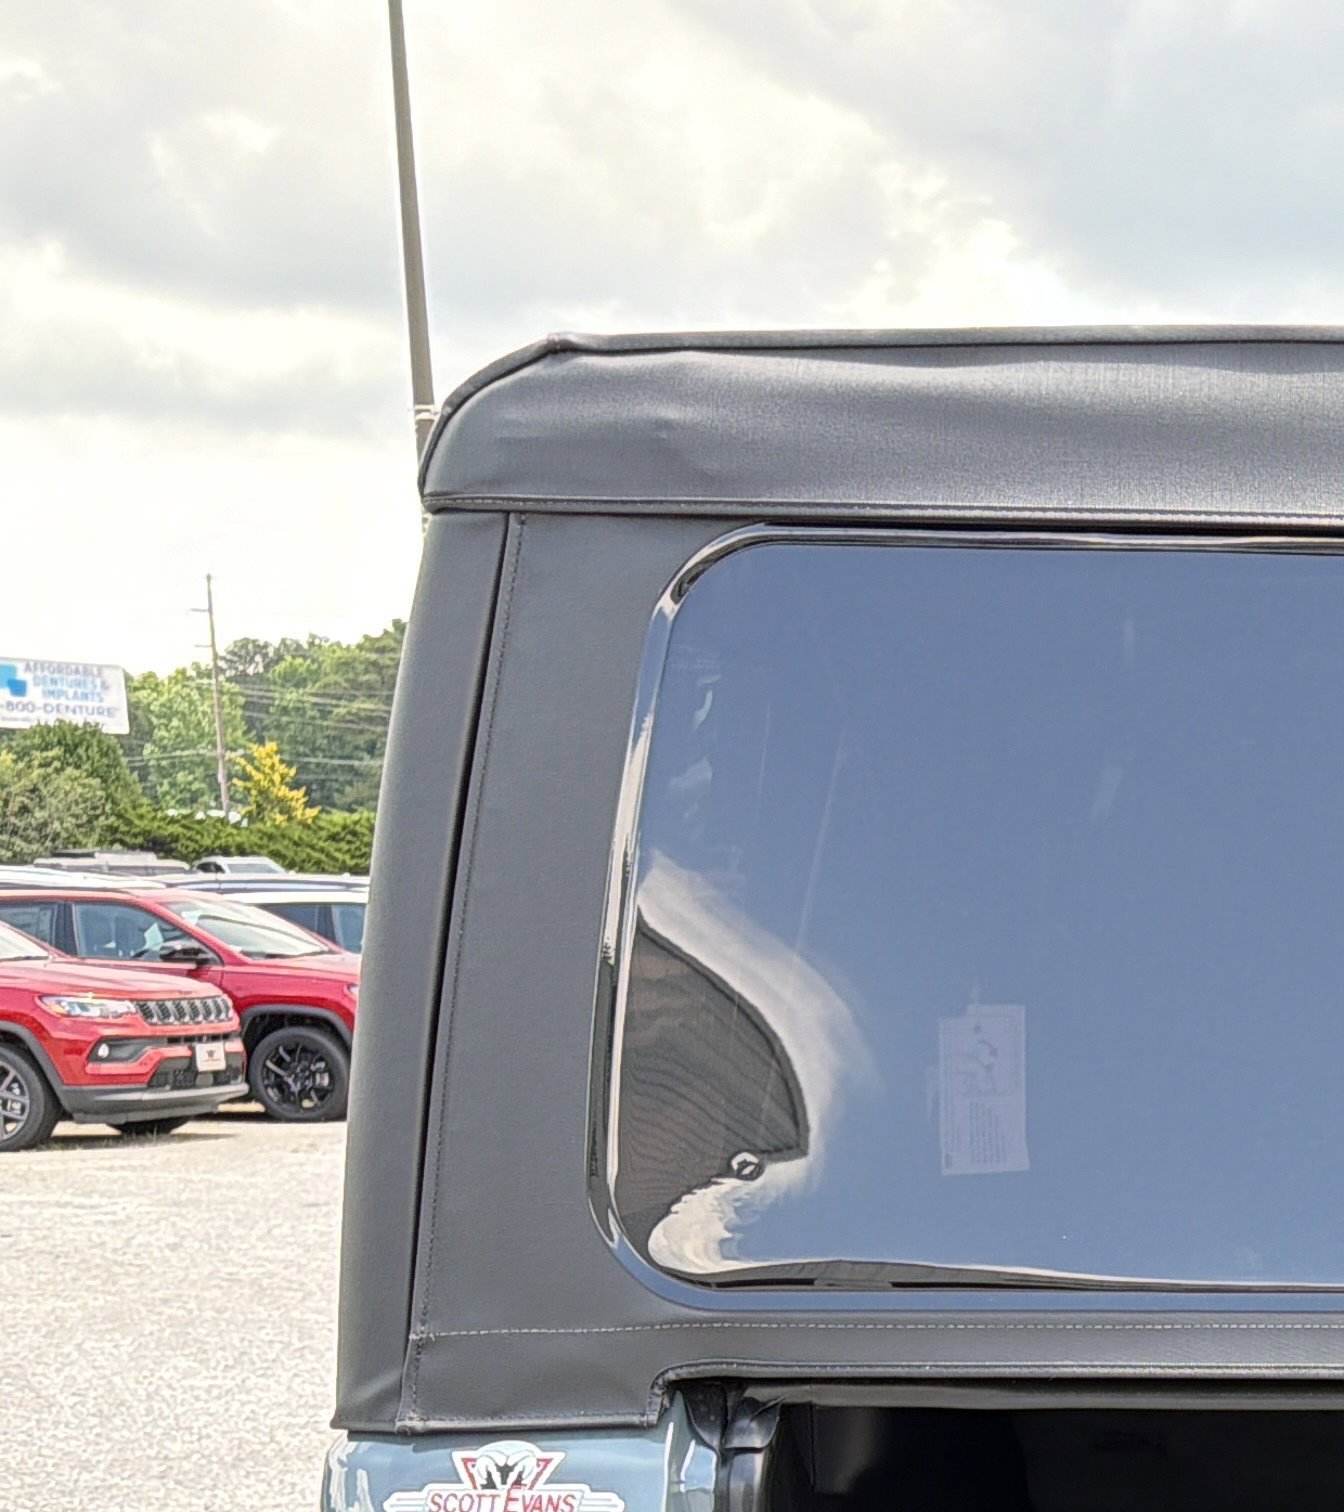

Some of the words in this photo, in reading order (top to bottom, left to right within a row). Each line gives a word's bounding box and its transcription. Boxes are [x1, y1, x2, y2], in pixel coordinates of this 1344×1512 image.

[24, 661, 104, 678] AFFORDABLE
[32, 675, 97, 691] DENTURES
[42, 689, 104, 703] IMPLANTS
